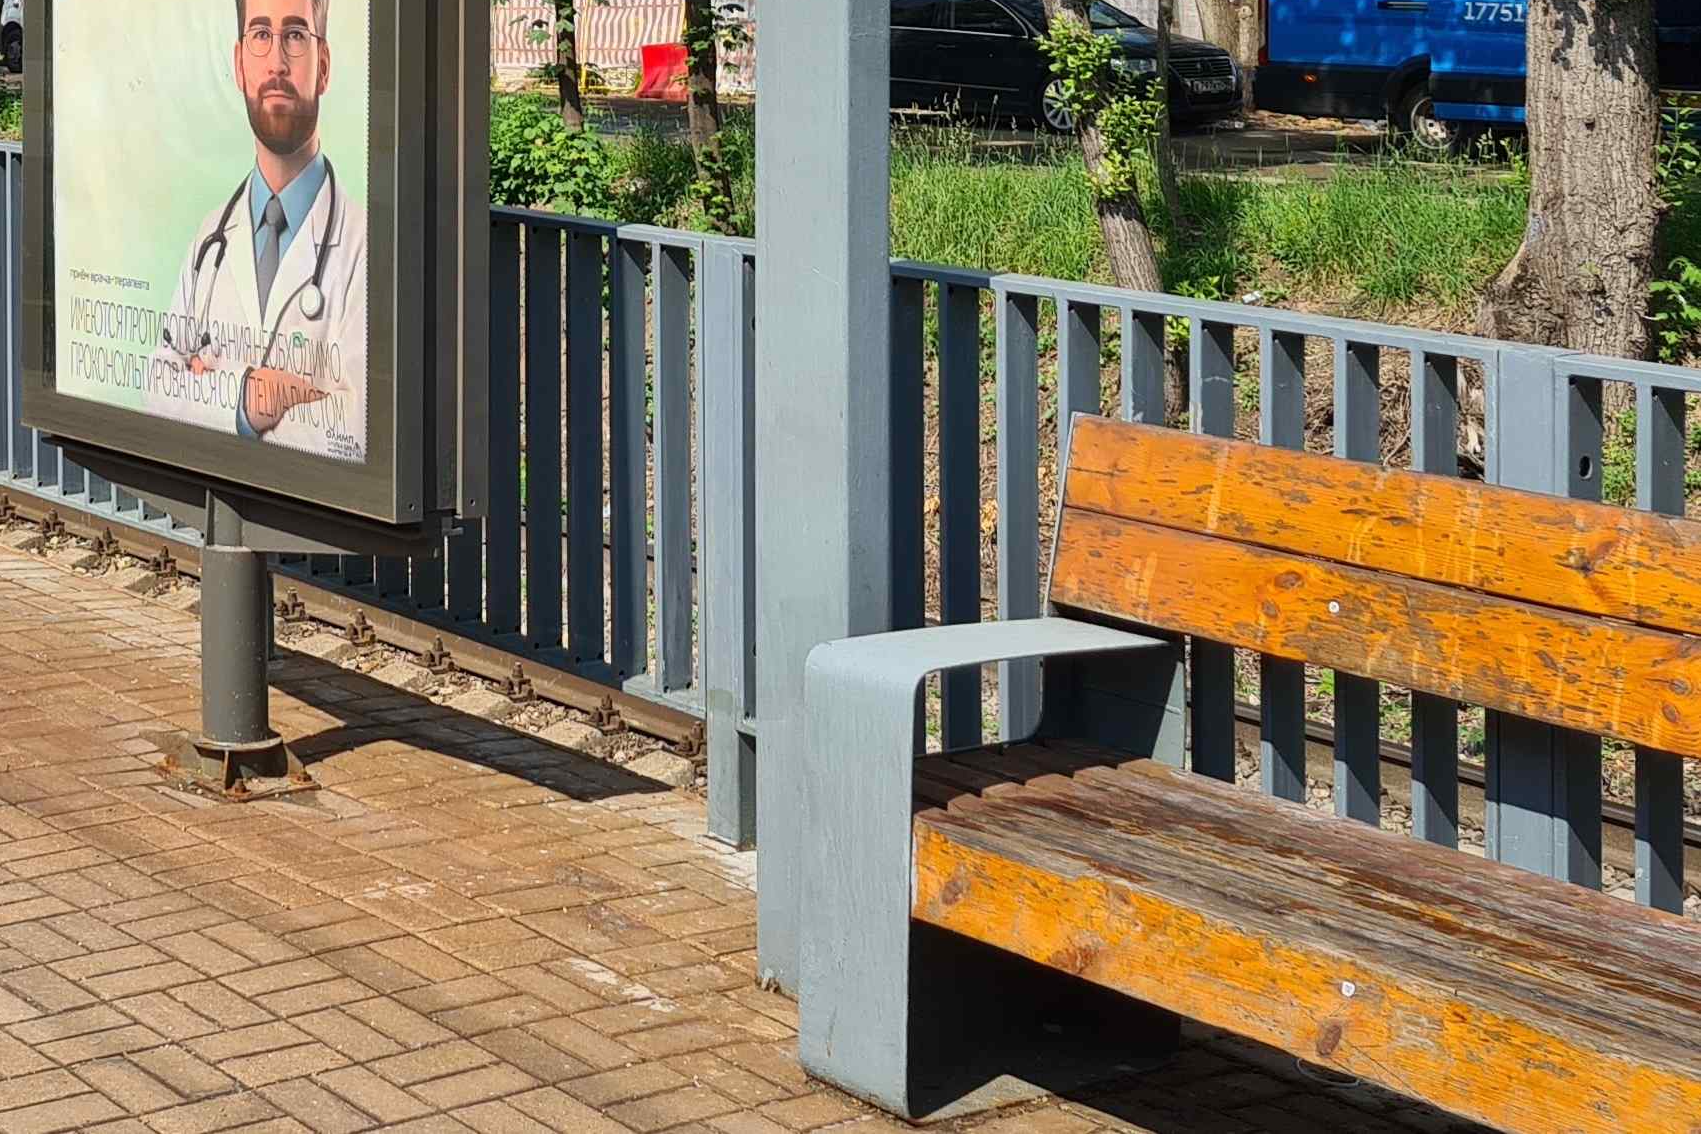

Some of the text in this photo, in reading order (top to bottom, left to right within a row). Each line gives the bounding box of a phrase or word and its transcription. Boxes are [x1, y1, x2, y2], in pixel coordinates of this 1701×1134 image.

[1464, 1, 1524, 22] 17751
[70, 296, 122, 340] ИМЕЮТСЯ
[70, 340, 346, 433] ПРОКОНСУЛЬТИРОВАТЬСЯ СО ПЕЦИАЛИСТОМ
